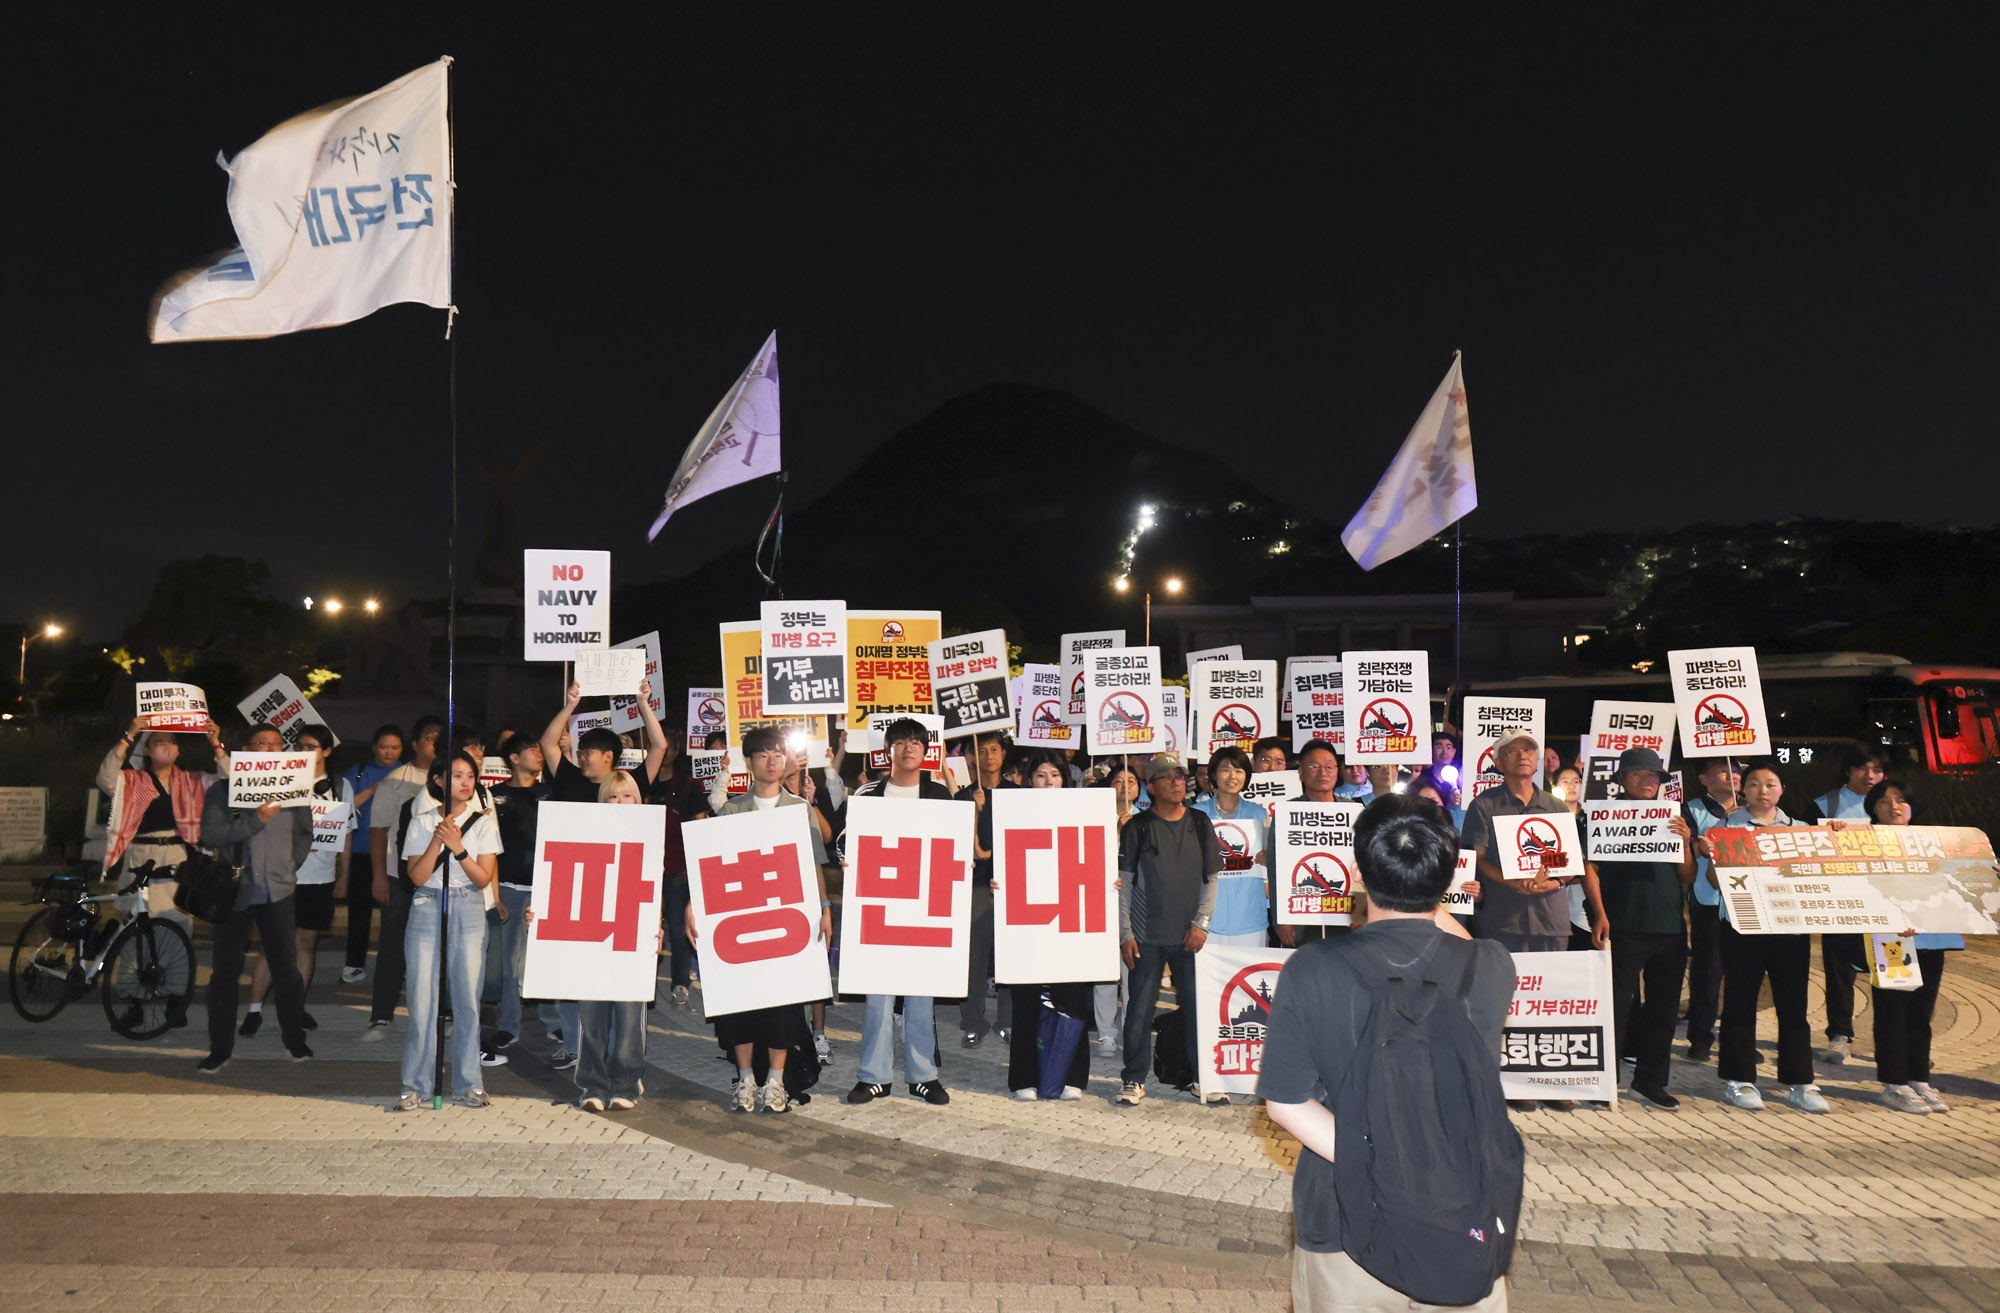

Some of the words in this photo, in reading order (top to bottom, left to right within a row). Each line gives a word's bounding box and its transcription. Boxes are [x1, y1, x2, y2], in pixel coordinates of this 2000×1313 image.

[552, 565, 584, 581] NO
[538, 590, 598, 606] NAVY
[558, 614, 577, 625] TO
[780, 612, 826, 627] 정부는
[534, 632, 602, 644] HORMUZ!
[772, 632, 802, 648] 파병
[806, 632, 836, 647] 요구
[1072, 638, 1113, 652] 침략전쟁
[856, 646, 892, 658] 이재명
[896, 646, 928, 658] 정부는
[942, 640, 984, 660] 미국의
[772, 658, 814, 680] 거부
[936, 662, 966, 679] 파병
[968, 656, 998, 673] 압박
[1096, 656, 1148, 670] 굴종외교
[1358, 662, 1412, 676] 침략전쟁
[1686, 660, 1742, 674] 파병논의
[1034, 673, 1060, 684] 파병논
[1094, 672, 1151, 687] 중단하라!
[1211, 670, 1262, 682] 파병논의
[1294, 672, 1342, 692] 침략을
[1686, 676, 1746, 690] 중단하라!
[788, 677, 840, 702] 하라!
[1032, 685, 1060, 696] 중단하
[1210, 686, 1264, 699] 중단하라!
[1358, 679, 1412, 692] 가담하는
[140, 688, 188, 700] 대미투자,
[941, 682, 980, 710] 규탄
[250, 689, 287, 724] 침략을
[270, 700, 304, 728] 멈춰라!
[957, 696, 1005, 725] 한다!
[1478, 706, 1532, 722] 침략전쟁
[578, 716, 612, 729] 파병논의
[1296, 710, 1344, 730] 전쟁을
[1609, 714, 1654, 730] 미국의
[1100, 728, 1152, 745] 파병반대
[1360, 736, 1414, 752] 파병반대
[1596, 734, 1628, 750] 파병
[1632, 735, 1663, 751] 압박
[1698, 730, 1754, 746] 파병반대
[234, 762, 252, 772] DO
[254, 760, 280, 771] NOT
[282, 758, 308, 770] JOIN
[234, 778, 243, 787] A
[247, 776, 276, 786] WAR
[279, 775, 294, 786] OF
[234, 788, 310, 802] AGGRESSION!
[1290, 812, 1350, 827] 파병논의
[1591, 810, 1609, 820] DO
[1612, 809, 1638, 820] NOT
[1641, 808, 1672, 819] JOIN
[1288, 830, 1352, 846] 중단하라!
[1592, 827, 1601, 838] A
[1606, 826, 1636, 836] WAR
[1640, 826, 1658, 836] OF
[1594, 842, 1680, 854] AGGRESSION!
[1756, 831, 1837, 861] 호르무즈
[1835, 830, 1902, 858] 전쟁행
[1902, 830, 1946, 858] 티켓
[1520, 854, 1566, 869] 파병반대
[1791, 864, 1822, 874] 국민을
[1824, 862, 1869, 874] 전쟁터로
[1871, 862, 1904, 874] 보내는
[1906, 861, 1930, 873] 티켓
[1004, 826, 1106, 933] 대
[536, 841, 654, 952] 파
[856, 835, 965, 948] 반
[1794, 884, 1831, 894] 대한민국
[698, 842, 810, 964] 병
[1292, 896, 1352, 912] 파병반대
[1800, 900, 1835, 910] 호르무즈
[1837, 900, 1864, 909] 전쟁터
[1804, 916, 1830, 926] 한국군
[1837, 916, 1870, 926] 대한민국
[1872, 916, 1888, 925] 국민
[1525, 1000, 1598, 1016] 거부하라!
